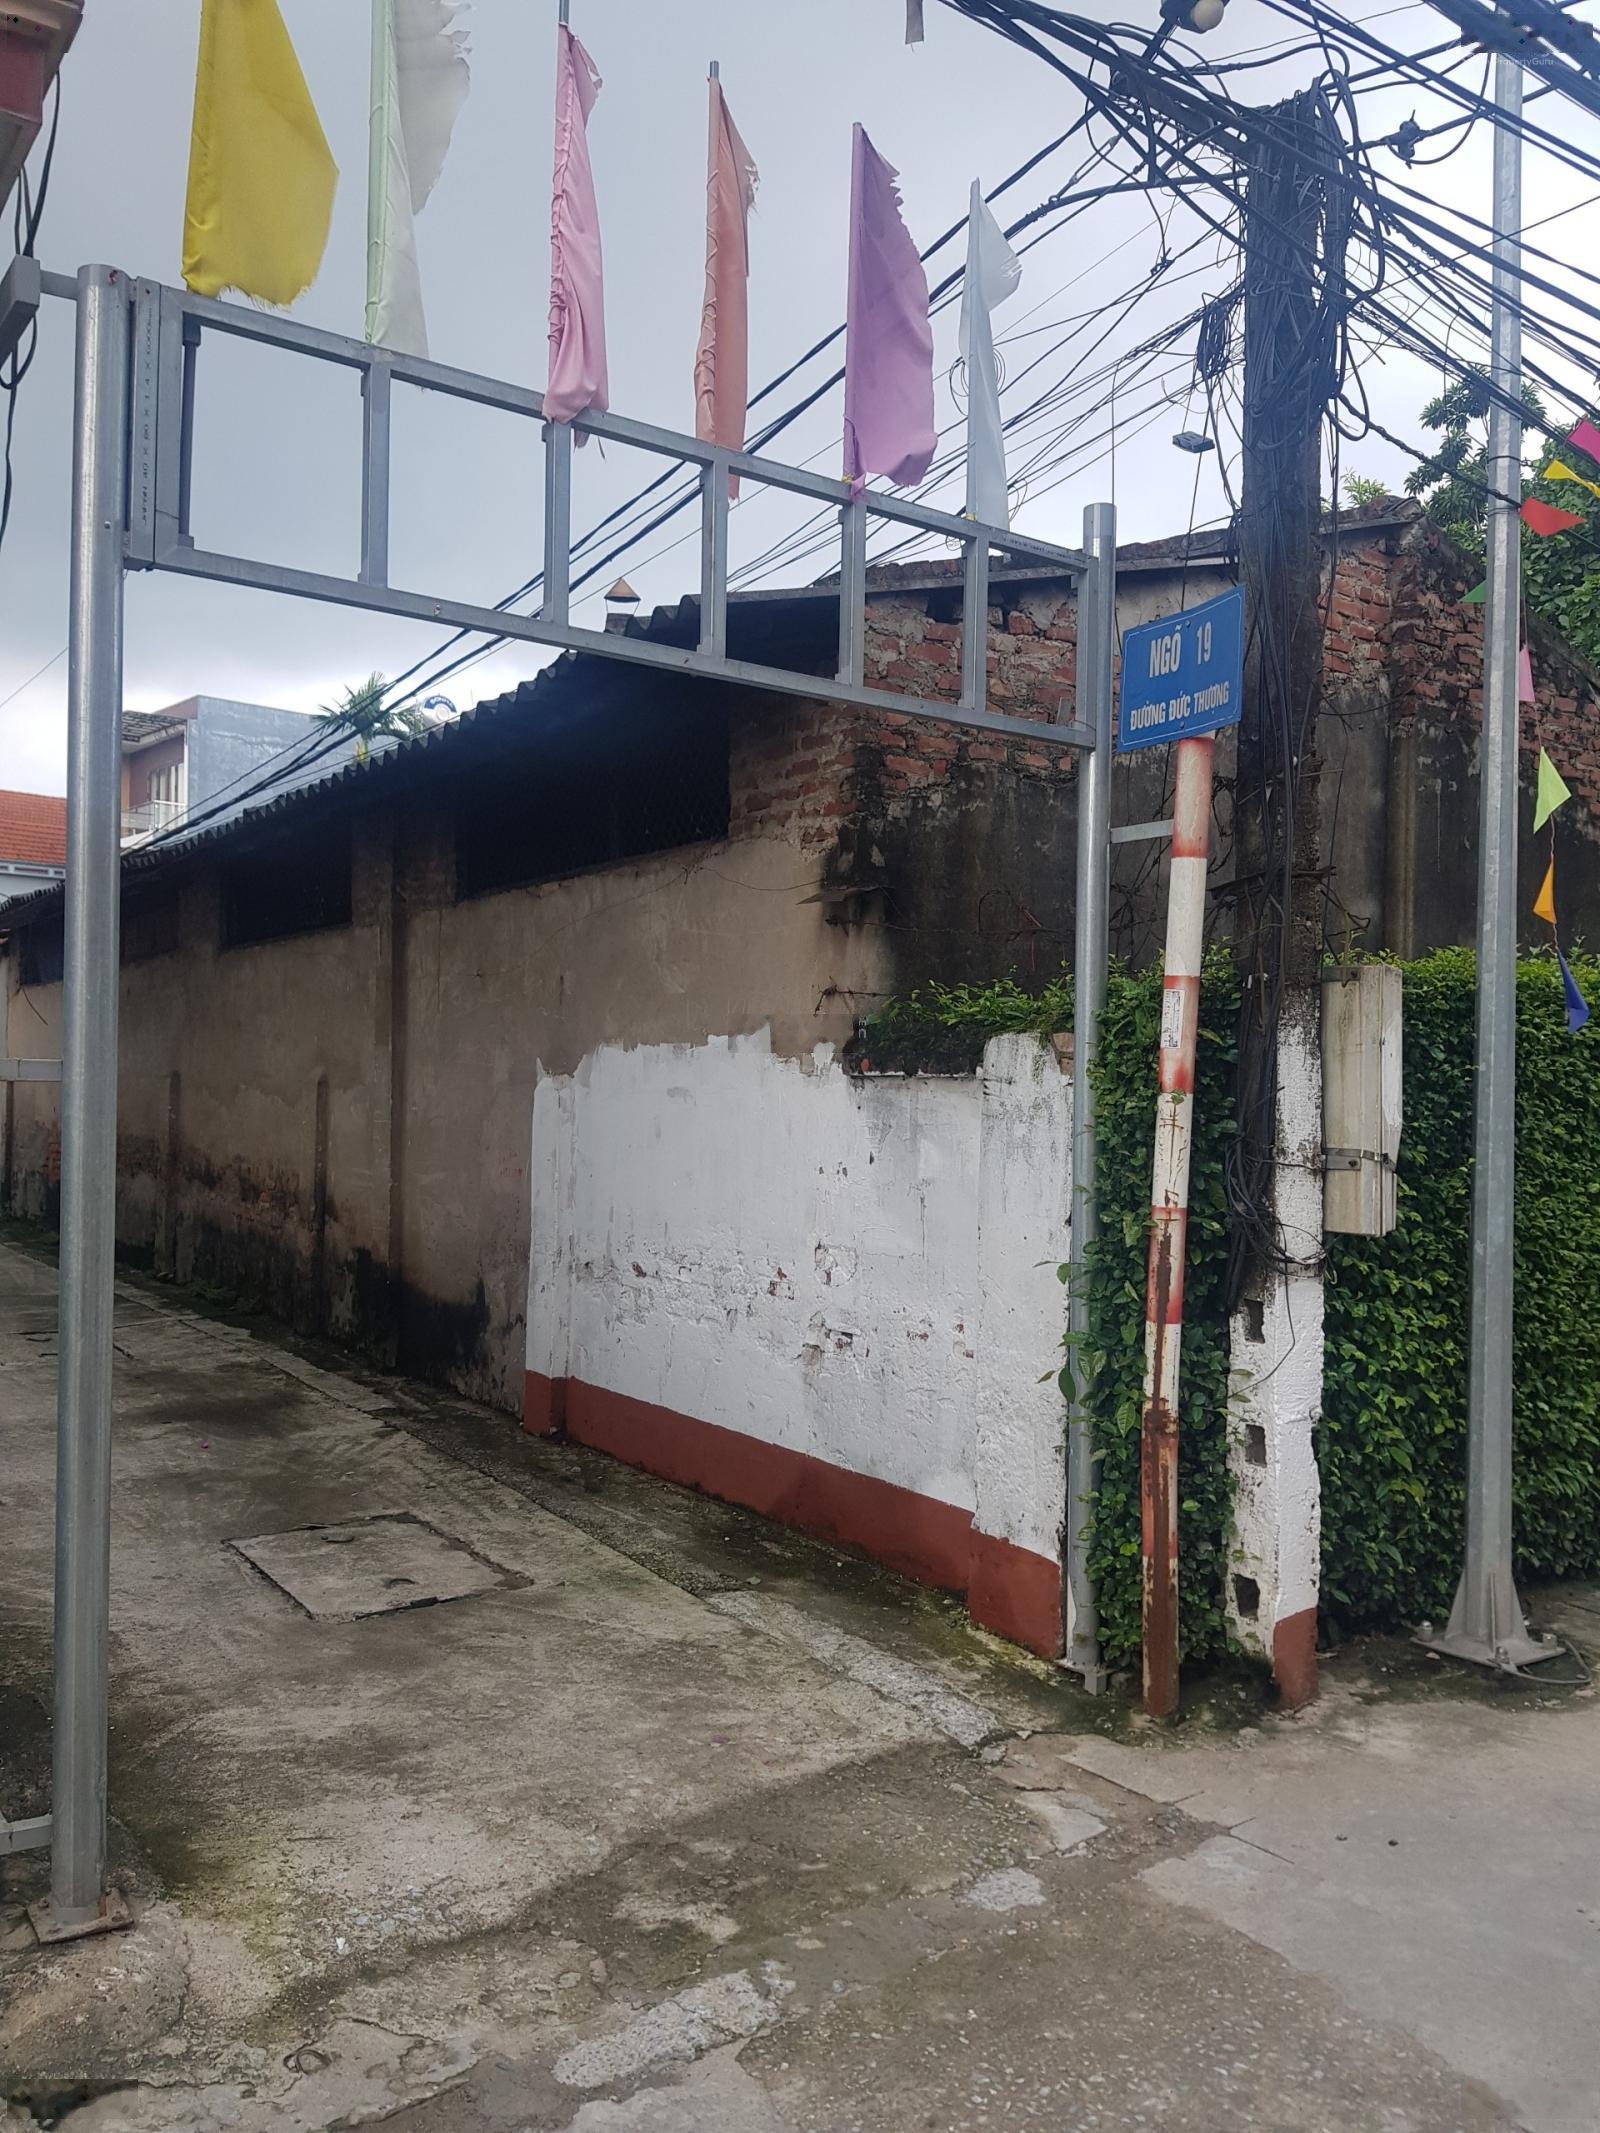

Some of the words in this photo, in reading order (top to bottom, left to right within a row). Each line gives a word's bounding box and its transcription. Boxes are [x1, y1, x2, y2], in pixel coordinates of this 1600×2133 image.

[1149, 624, 1182, 678] NGÕ
[1196, 621, 1212, 665] 19
[1130, 700, 1166, 731] ĐƯỜNG
[1168, 690, 1191, 721] ĐỨC
[1194, 681, 1230, 715] THƯỢNG
